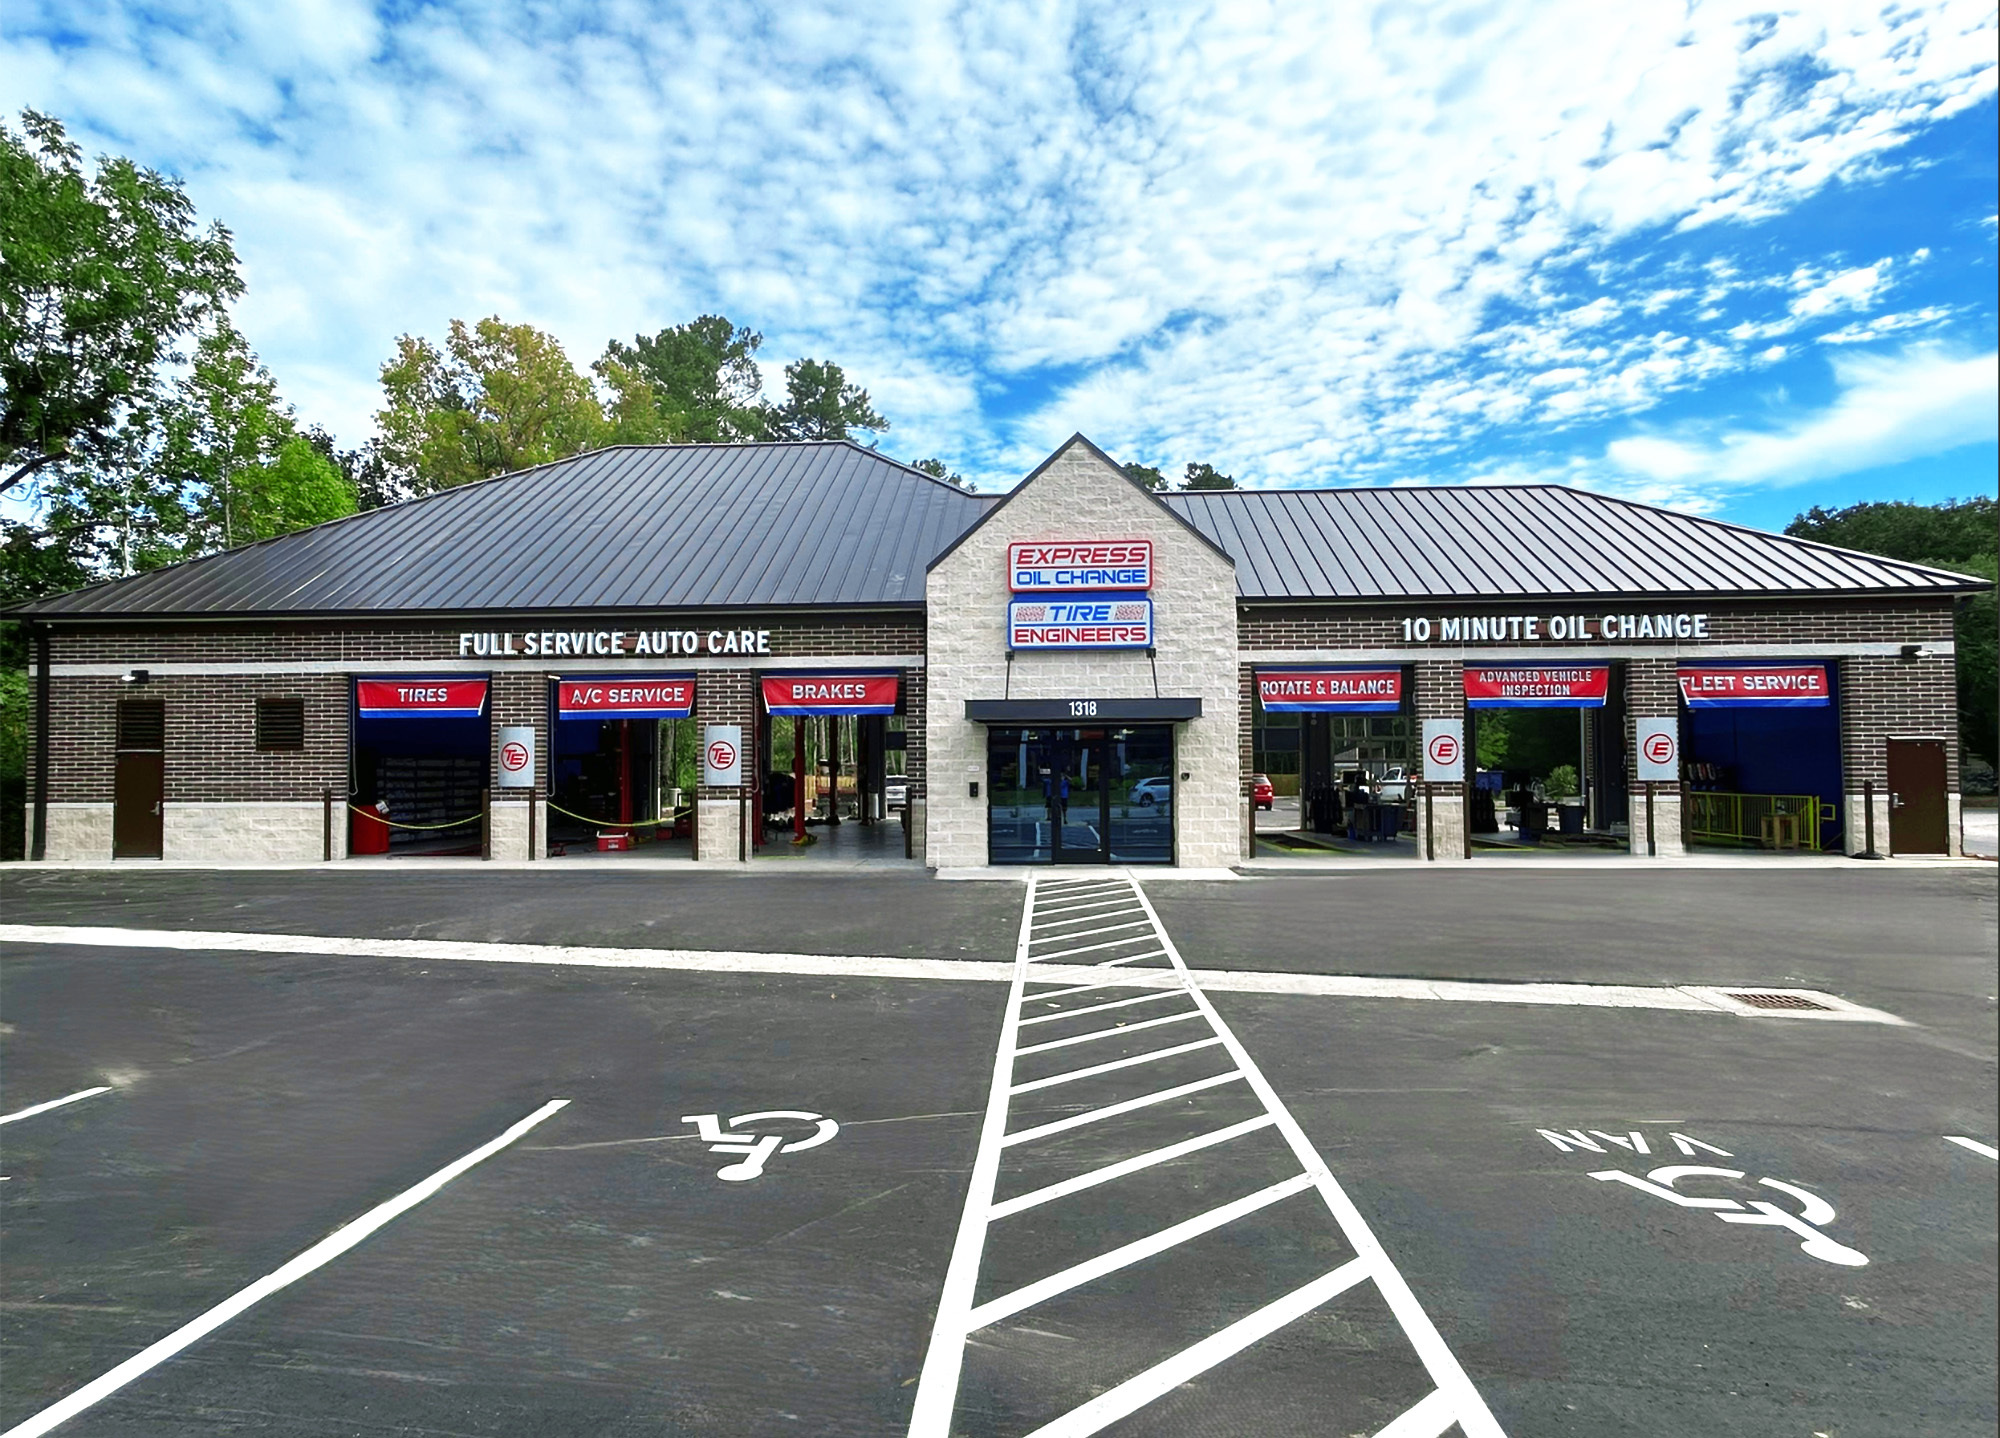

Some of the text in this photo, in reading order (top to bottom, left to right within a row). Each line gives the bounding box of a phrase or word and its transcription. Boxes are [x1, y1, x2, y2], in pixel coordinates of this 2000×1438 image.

[1016, 547, 1147, 565] EXPRESS
[1016, 569, 1147, 585] OIL CHANGE
[1049, 605, 1112, 621] TIRE
[1014, 627, 1147, 643] ENGINEERS
[1402, 613, 1710, 642] 10 MINUTE OIL CHANGE
[459, 630, 771, 655] FULL SERVICE AUTO CARE
[1479, 671, 1592, 682] ADVANCED VEHICLE
[1679, 675, 1821, 691] FLEET SERVICE
[397, 688, 448, 702] TIRES
[792, 684, 866, 699] BRAKES
[1260, 680, 1396, 695] ROTATE & BALANCE
[1501, 684, 1571, 696] INSPECTION
[571, 687, 685, 705] A/C SERVICE
[1068, 701, 1097, 716] 1318
[1437, 743, 1454, 757] E
[1652, 742, 1670, 755] E
[1535, 1128, 1735, 1157] VAN
